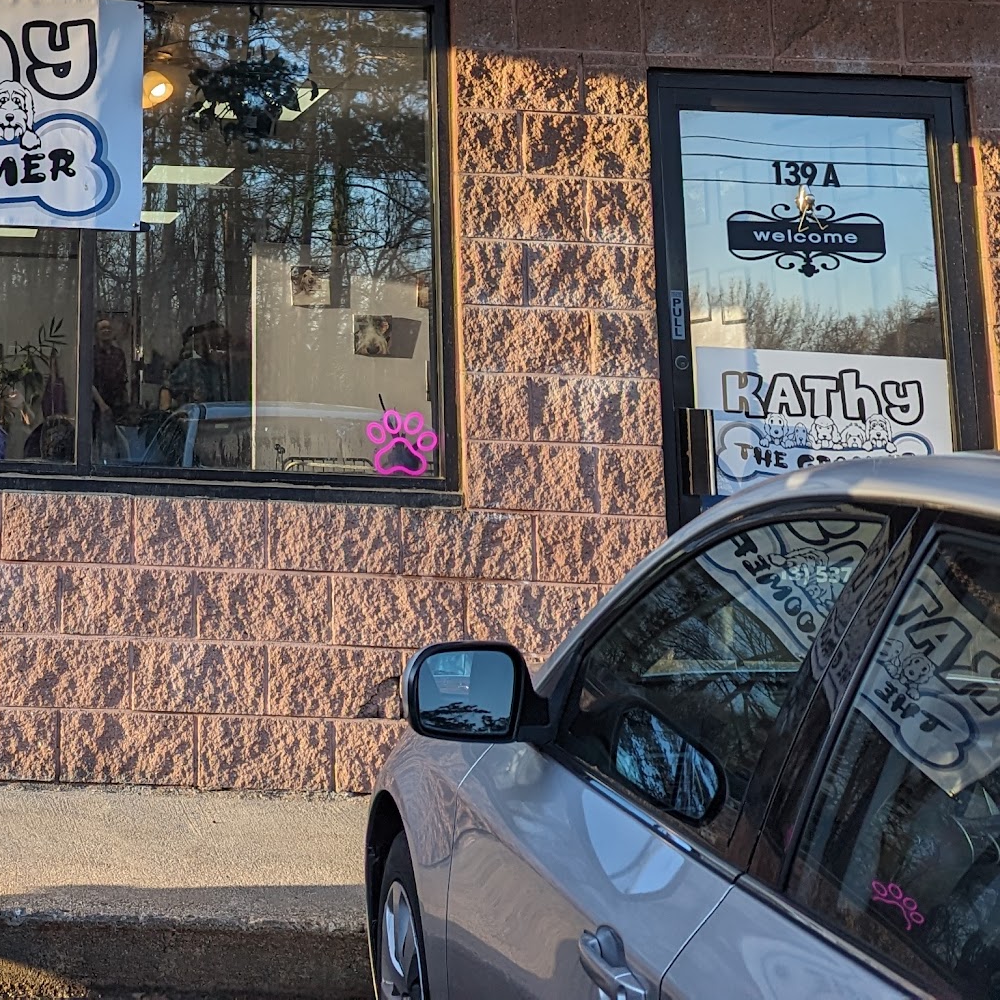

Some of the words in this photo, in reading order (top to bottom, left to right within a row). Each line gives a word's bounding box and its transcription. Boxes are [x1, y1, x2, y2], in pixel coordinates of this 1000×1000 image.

[771, 160, 818, 186] 139
[822, 162, 841, 188] A
[753, 229, 858, 243] welcome
[672, 297, 683, 337] PULL
[734, 442, 789, 470] THE
